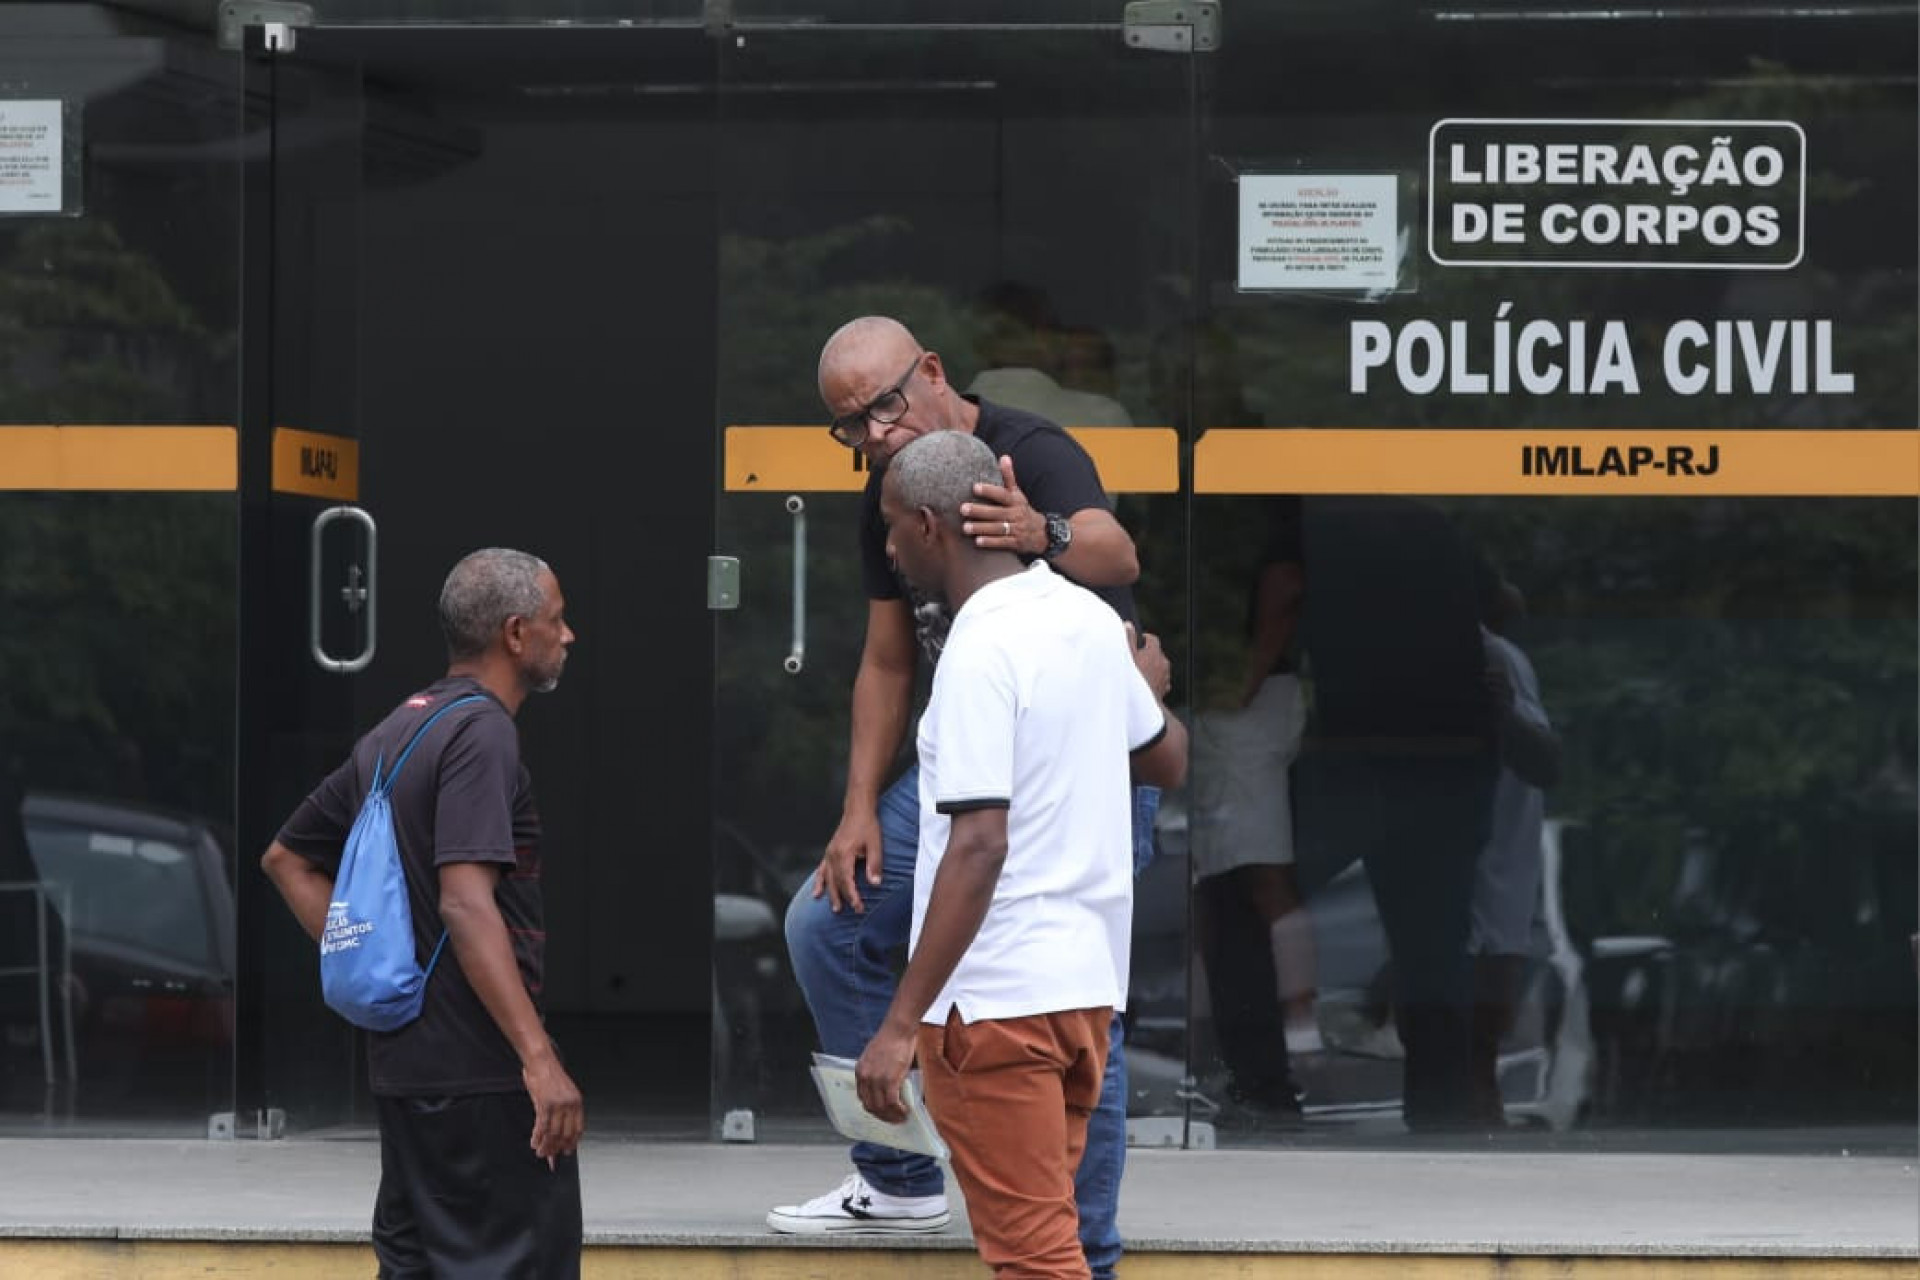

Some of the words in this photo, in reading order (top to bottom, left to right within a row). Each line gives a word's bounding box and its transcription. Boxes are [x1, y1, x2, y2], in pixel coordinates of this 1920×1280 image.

[1450, 136, 1784, 196] LIBERAÇÃO
[1451, 203, 1525, 245] DE
[1540, 203, 1780, 246] CORPOS
[1350, 301, 1641, 395] POLÍCIA
[1663, 319, 1855, 395] CIVIL
[1520, 444, 1720, 478] IMLAP-RJ
